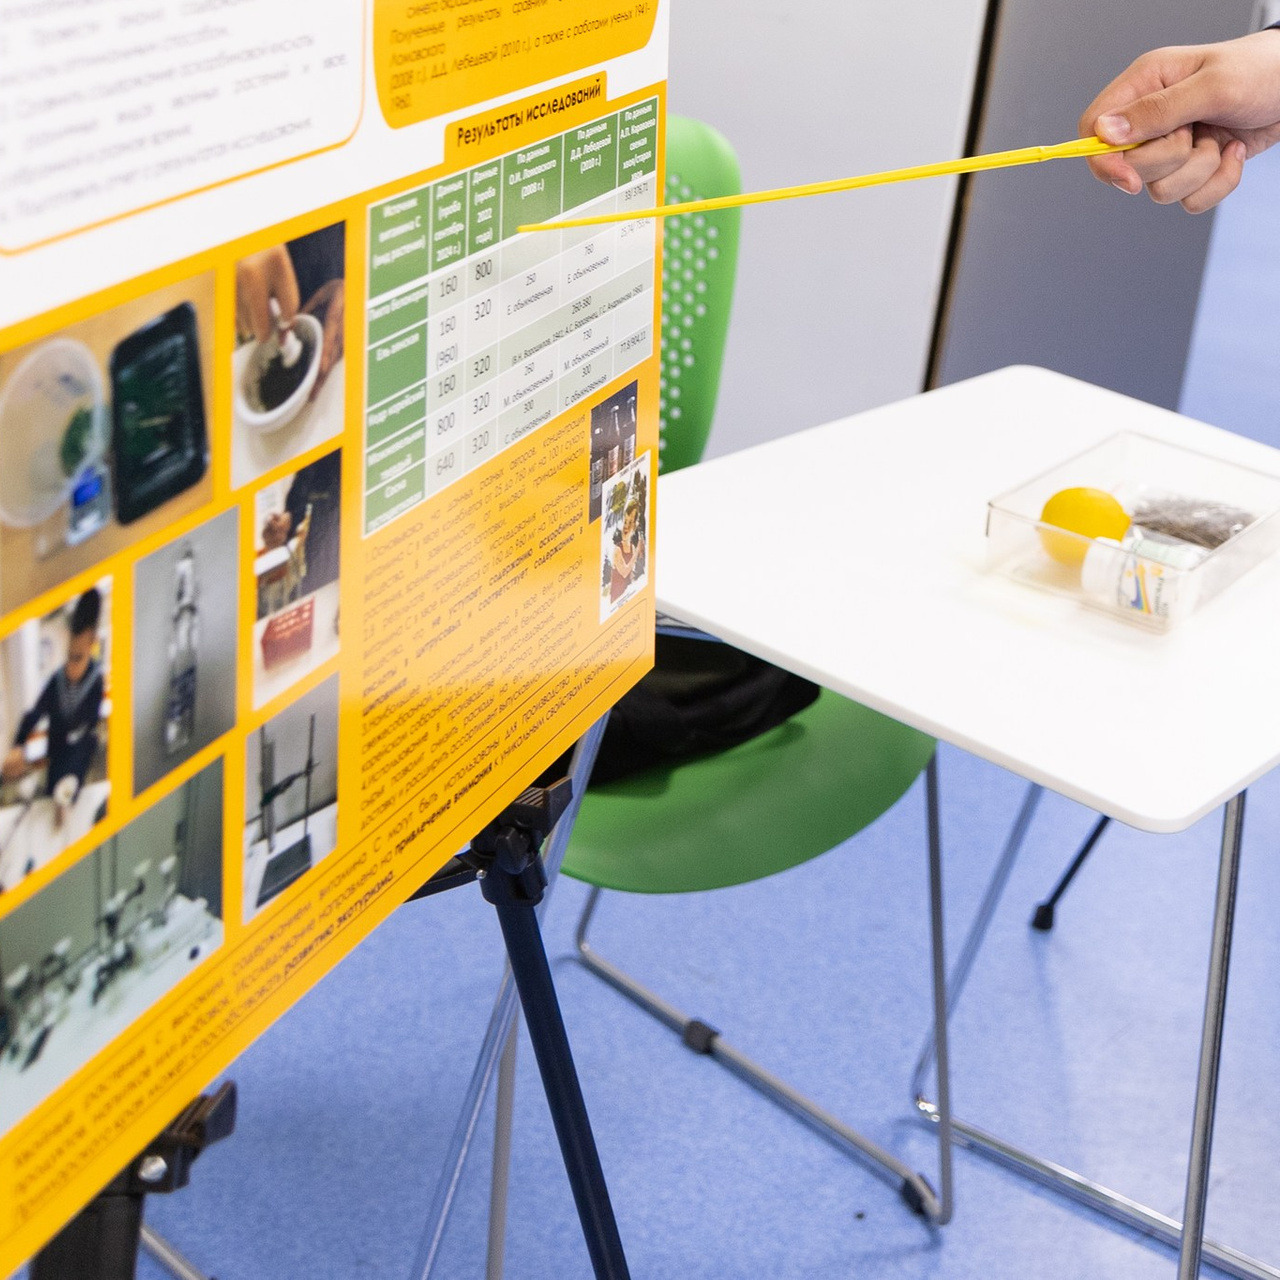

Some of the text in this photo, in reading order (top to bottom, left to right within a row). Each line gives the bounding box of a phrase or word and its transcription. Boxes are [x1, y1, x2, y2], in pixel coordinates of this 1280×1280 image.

[457, 78, 602, 147] Результаты исследований
[439, 257, 492, 298] 160 800
[573, 253, 609, 281] обыкновенная
[439, 242, 593, 338] 160 320 250 760
[513, 281, 553, 313] обыкновенная
[436, 341, 458, 372] (960)
[438, 353, 490, 398] 160 320
[436, 409, 455, 437] 800
[472, 389, 489, 416] 320
[582, 326, 592, 342] 730
[436, 362, 591, 477] 640 320 300 300
